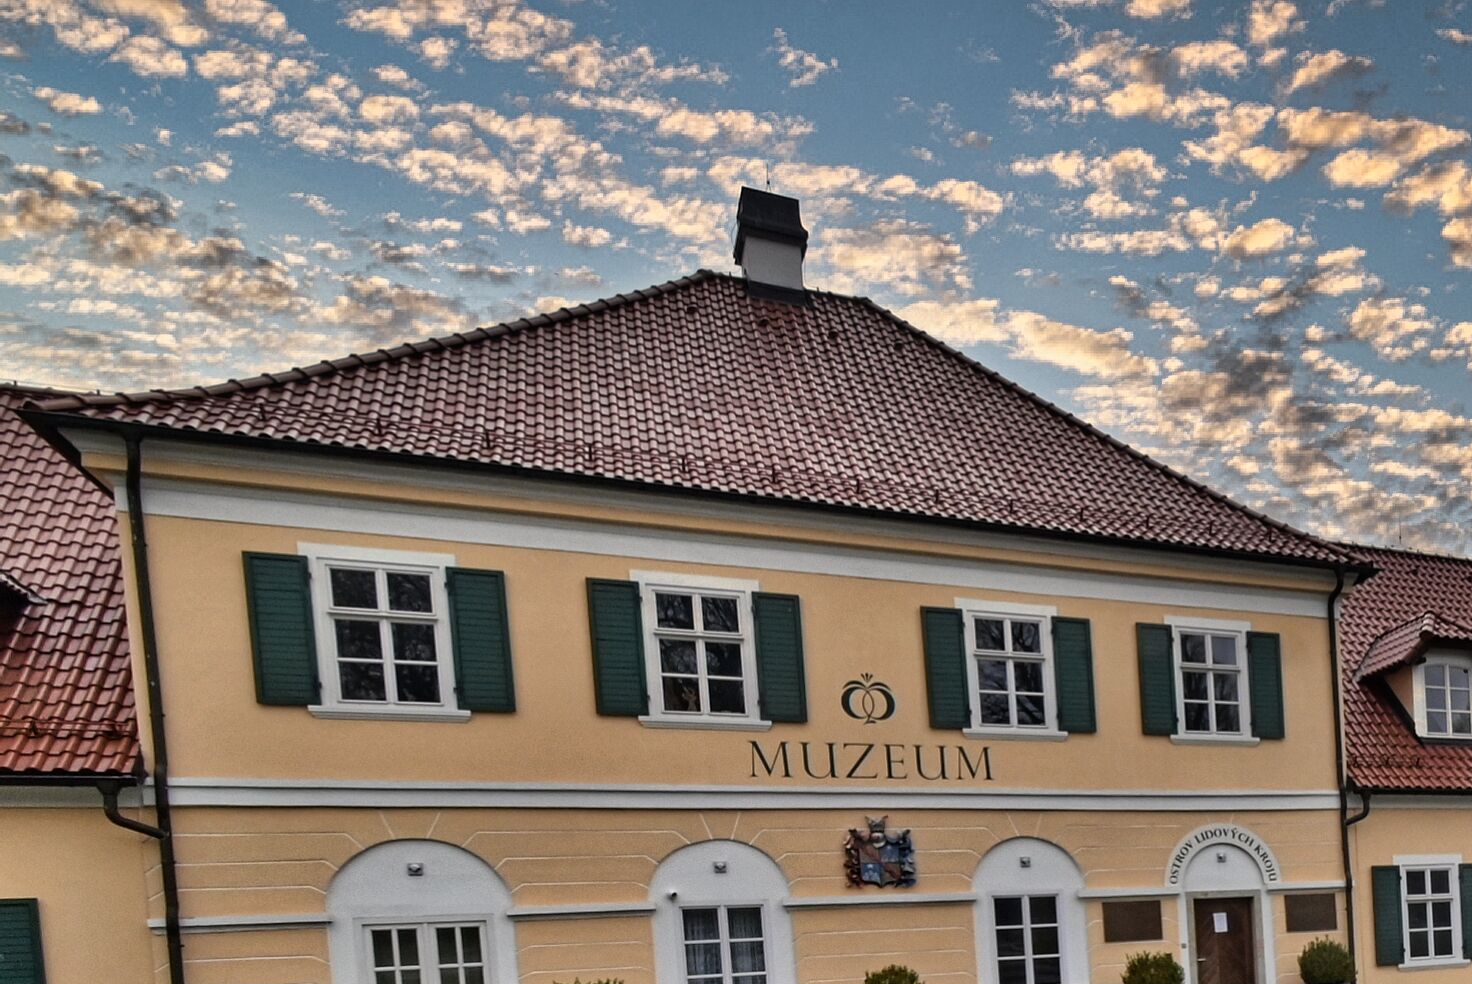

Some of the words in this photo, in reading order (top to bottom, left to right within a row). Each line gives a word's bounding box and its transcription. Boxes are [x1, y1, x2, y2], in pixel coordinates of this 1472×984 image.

[749, 740, 994, 780] MUZEUM
[1169, 840, 1193, 884] OSTROV
[1194, 827, 1254, 846] LIDOVÝCH
